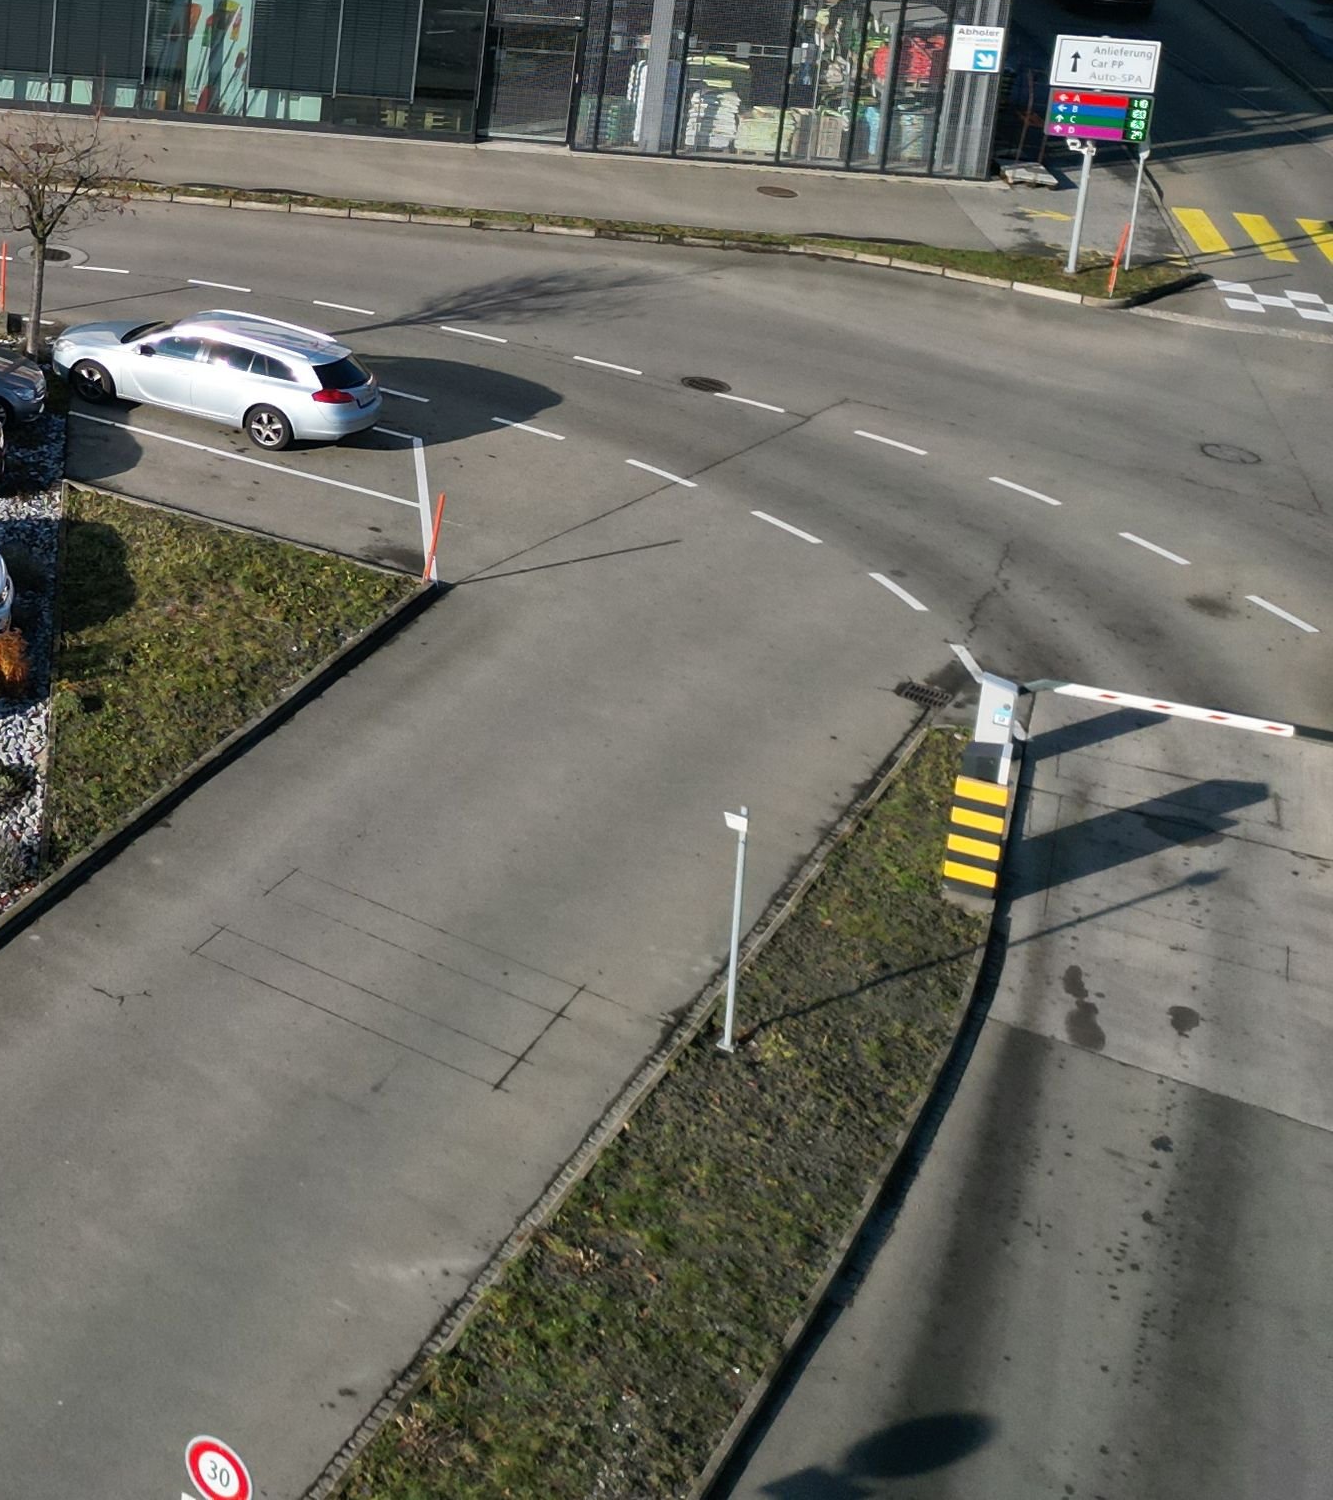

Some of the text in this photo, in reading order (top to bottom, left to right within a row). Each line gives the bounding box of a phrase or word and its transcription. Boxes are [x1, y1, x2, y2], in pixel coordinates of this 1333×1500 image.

[957, 28, 1000, 37] Abholer
[1093, 46, 1153, 60] Anlieferung
[1091, 59, 1108, 69] Car
[1089, 72, 1142, 84] Auto-SPA
[1073, 94, 1080, 103] A
[1072, 105, 1079, 113] B
[1070, 115, 1077, 124] C
[1068, 126, 1075, 134] D
[207, 1460, 230, 1488] 30
